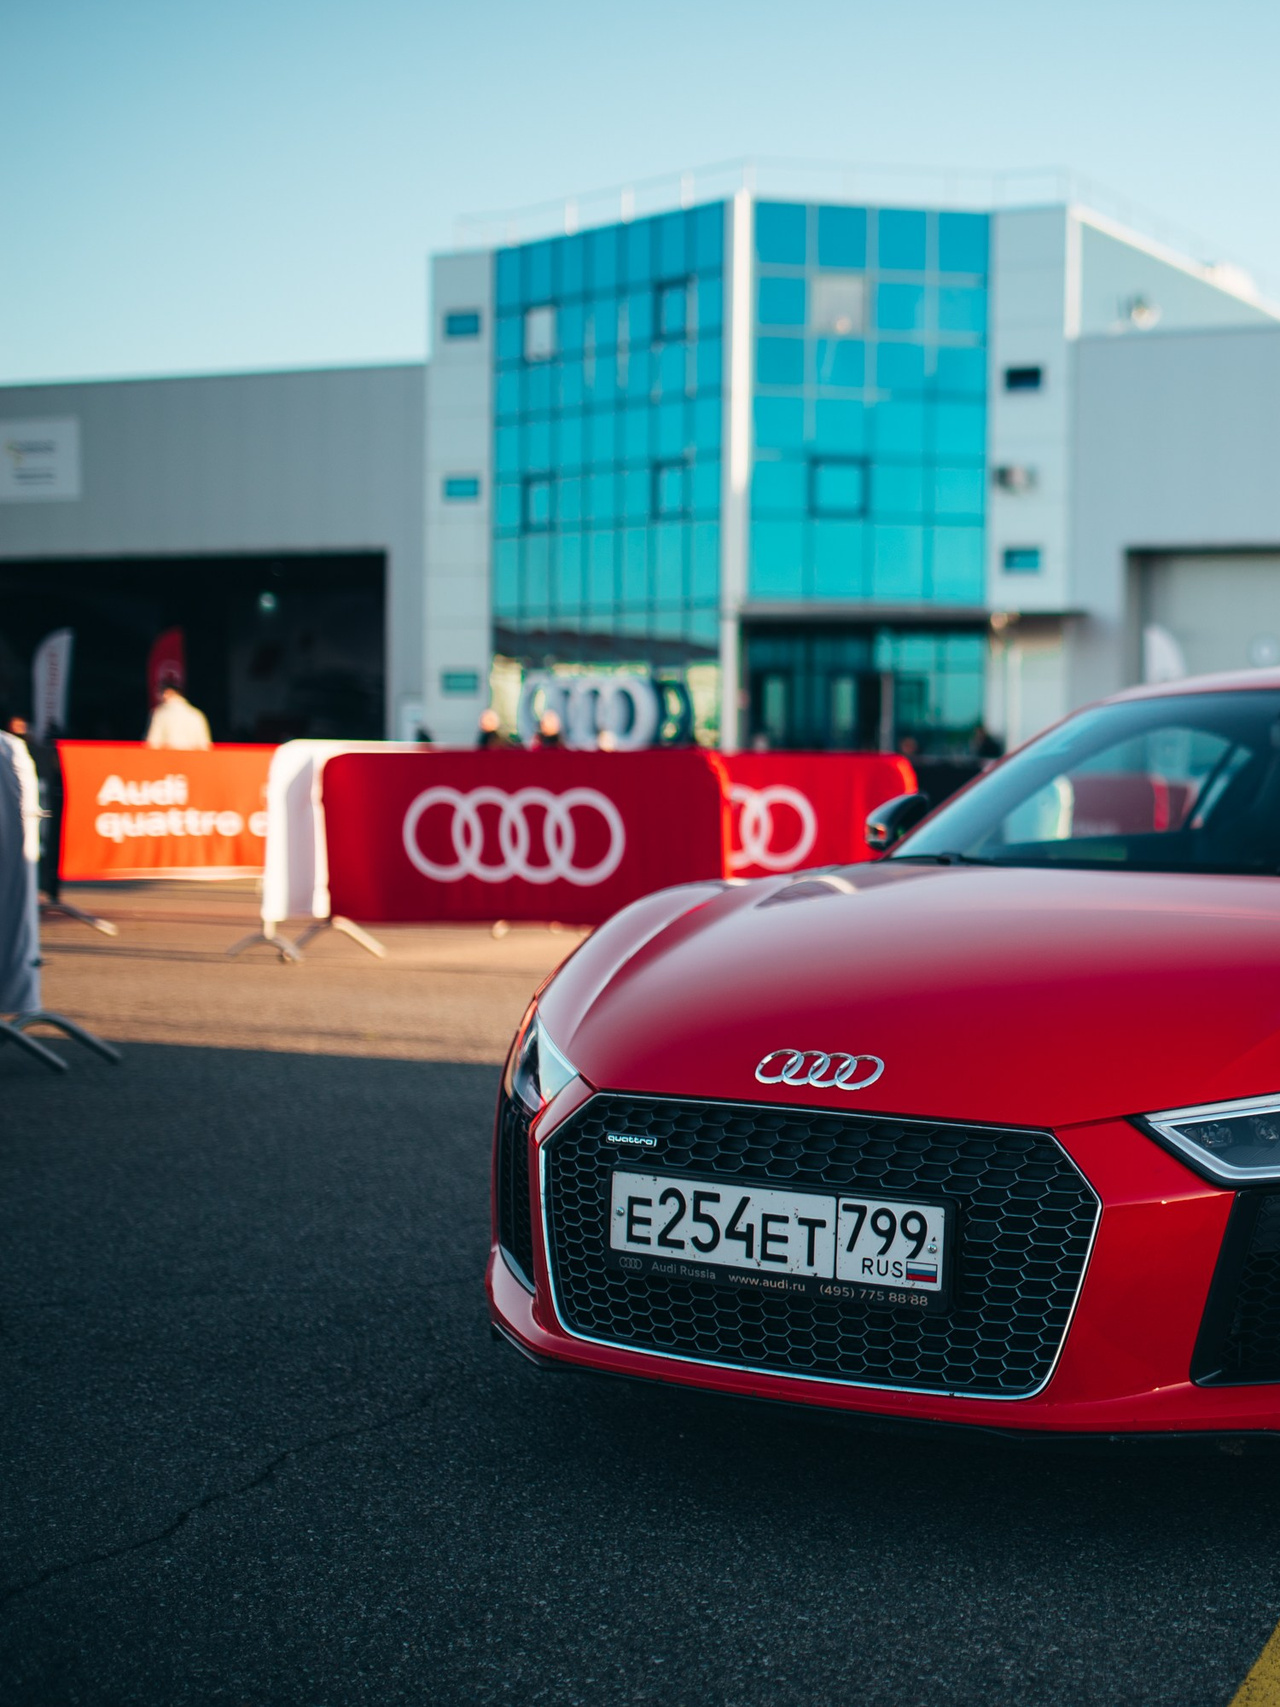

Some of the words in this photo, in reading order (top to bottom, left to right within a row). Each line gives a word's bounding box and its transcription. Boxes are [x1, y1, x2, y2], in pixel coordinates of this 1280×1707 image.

[97, 774, 188, 806] Audi
[95, 807, 244, 843] quattro
[607, 1134, 654, 1146] quattro
[626, 1186, 827, 1267] E254ET
[842, 1202, 928, 1259] 799
[651, 1261, 677, 1274] Audi
[680, 1265, 716, 1280] Russia
[728, 1273, 806, 1292] www.audi.ru
[819, 1284, 855, 1299] (495)
[859, 1288, 885, 1302] 775
[888, 1292, 907, 1304] 88
[861, 1257, 904, 1278] RUS
